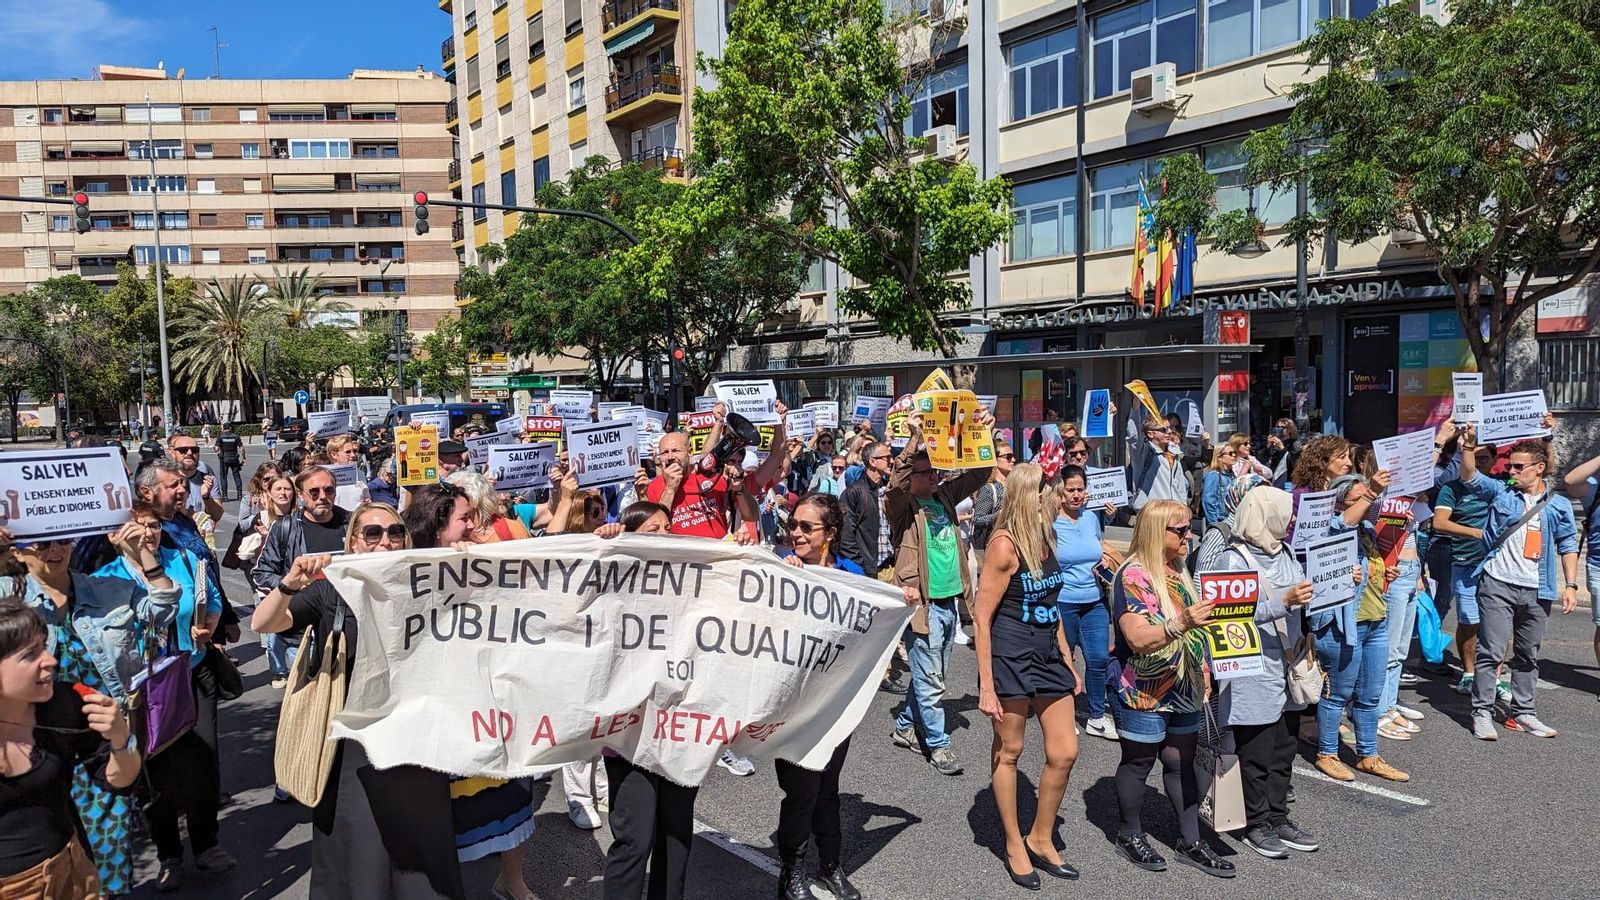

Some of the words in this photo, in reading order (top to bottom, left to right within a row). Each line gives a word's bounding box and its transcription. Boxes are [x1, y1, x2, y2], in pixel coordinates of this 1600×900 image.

[1044, 307, 1105, 326] OFICIAL
[1195, 296, 1219, 313] DE
[1222, 287, 1321, 310] VALÈNCA
[732, 387, 761, 396] SALVEM
[1354, 383, 1390, 391] aprende
[1508, 412, 1544, 421] RETALLADES
[528, 420, 561, 429] STOP
[476, 437, 500, 446] SALVEM
[588, 430, 621, 446] SALVEM
[972, 432, 982, 440] EOI
[508, 451, 540, 462] SALVEM
[22, 462, 88, 480] SALVEM
[24, 486, 95, 501] L'ENSENYAMENT
[1088, 490, 1123, 501] ECORTABLES
[26, 504, 58, 517] PÚBLIC
[59, 501, 102, 513] D'IDIOMES
[1382, 499, 1410, 514] STOP
[1299, 522, 1306, 530] NO
[1312, 520, 1320, 529] LES
[410, 558, 712, 598] ENSENYAMENT
[1312, 575, 1320, 584] NO
[1324, 572, 1332, 582] LOS
[1333, 565, 1354, 579] RECORTES
[1204, 579, 1257, 600] STOP
[1210, 606, 1254, 616] ETALLADES
[404, 593, 547, 650] PÚBLIC
[585, 614, 592, 648] I
[622, 614, 668, 650] DE
[695, 616, 845, 673] QUALITAT
[666, 660, 694, 681] EOI
[1216, 662, 1232, 672] UGT
[471, 708, 514, 743] NO
[531, 715, 557, 746] A
